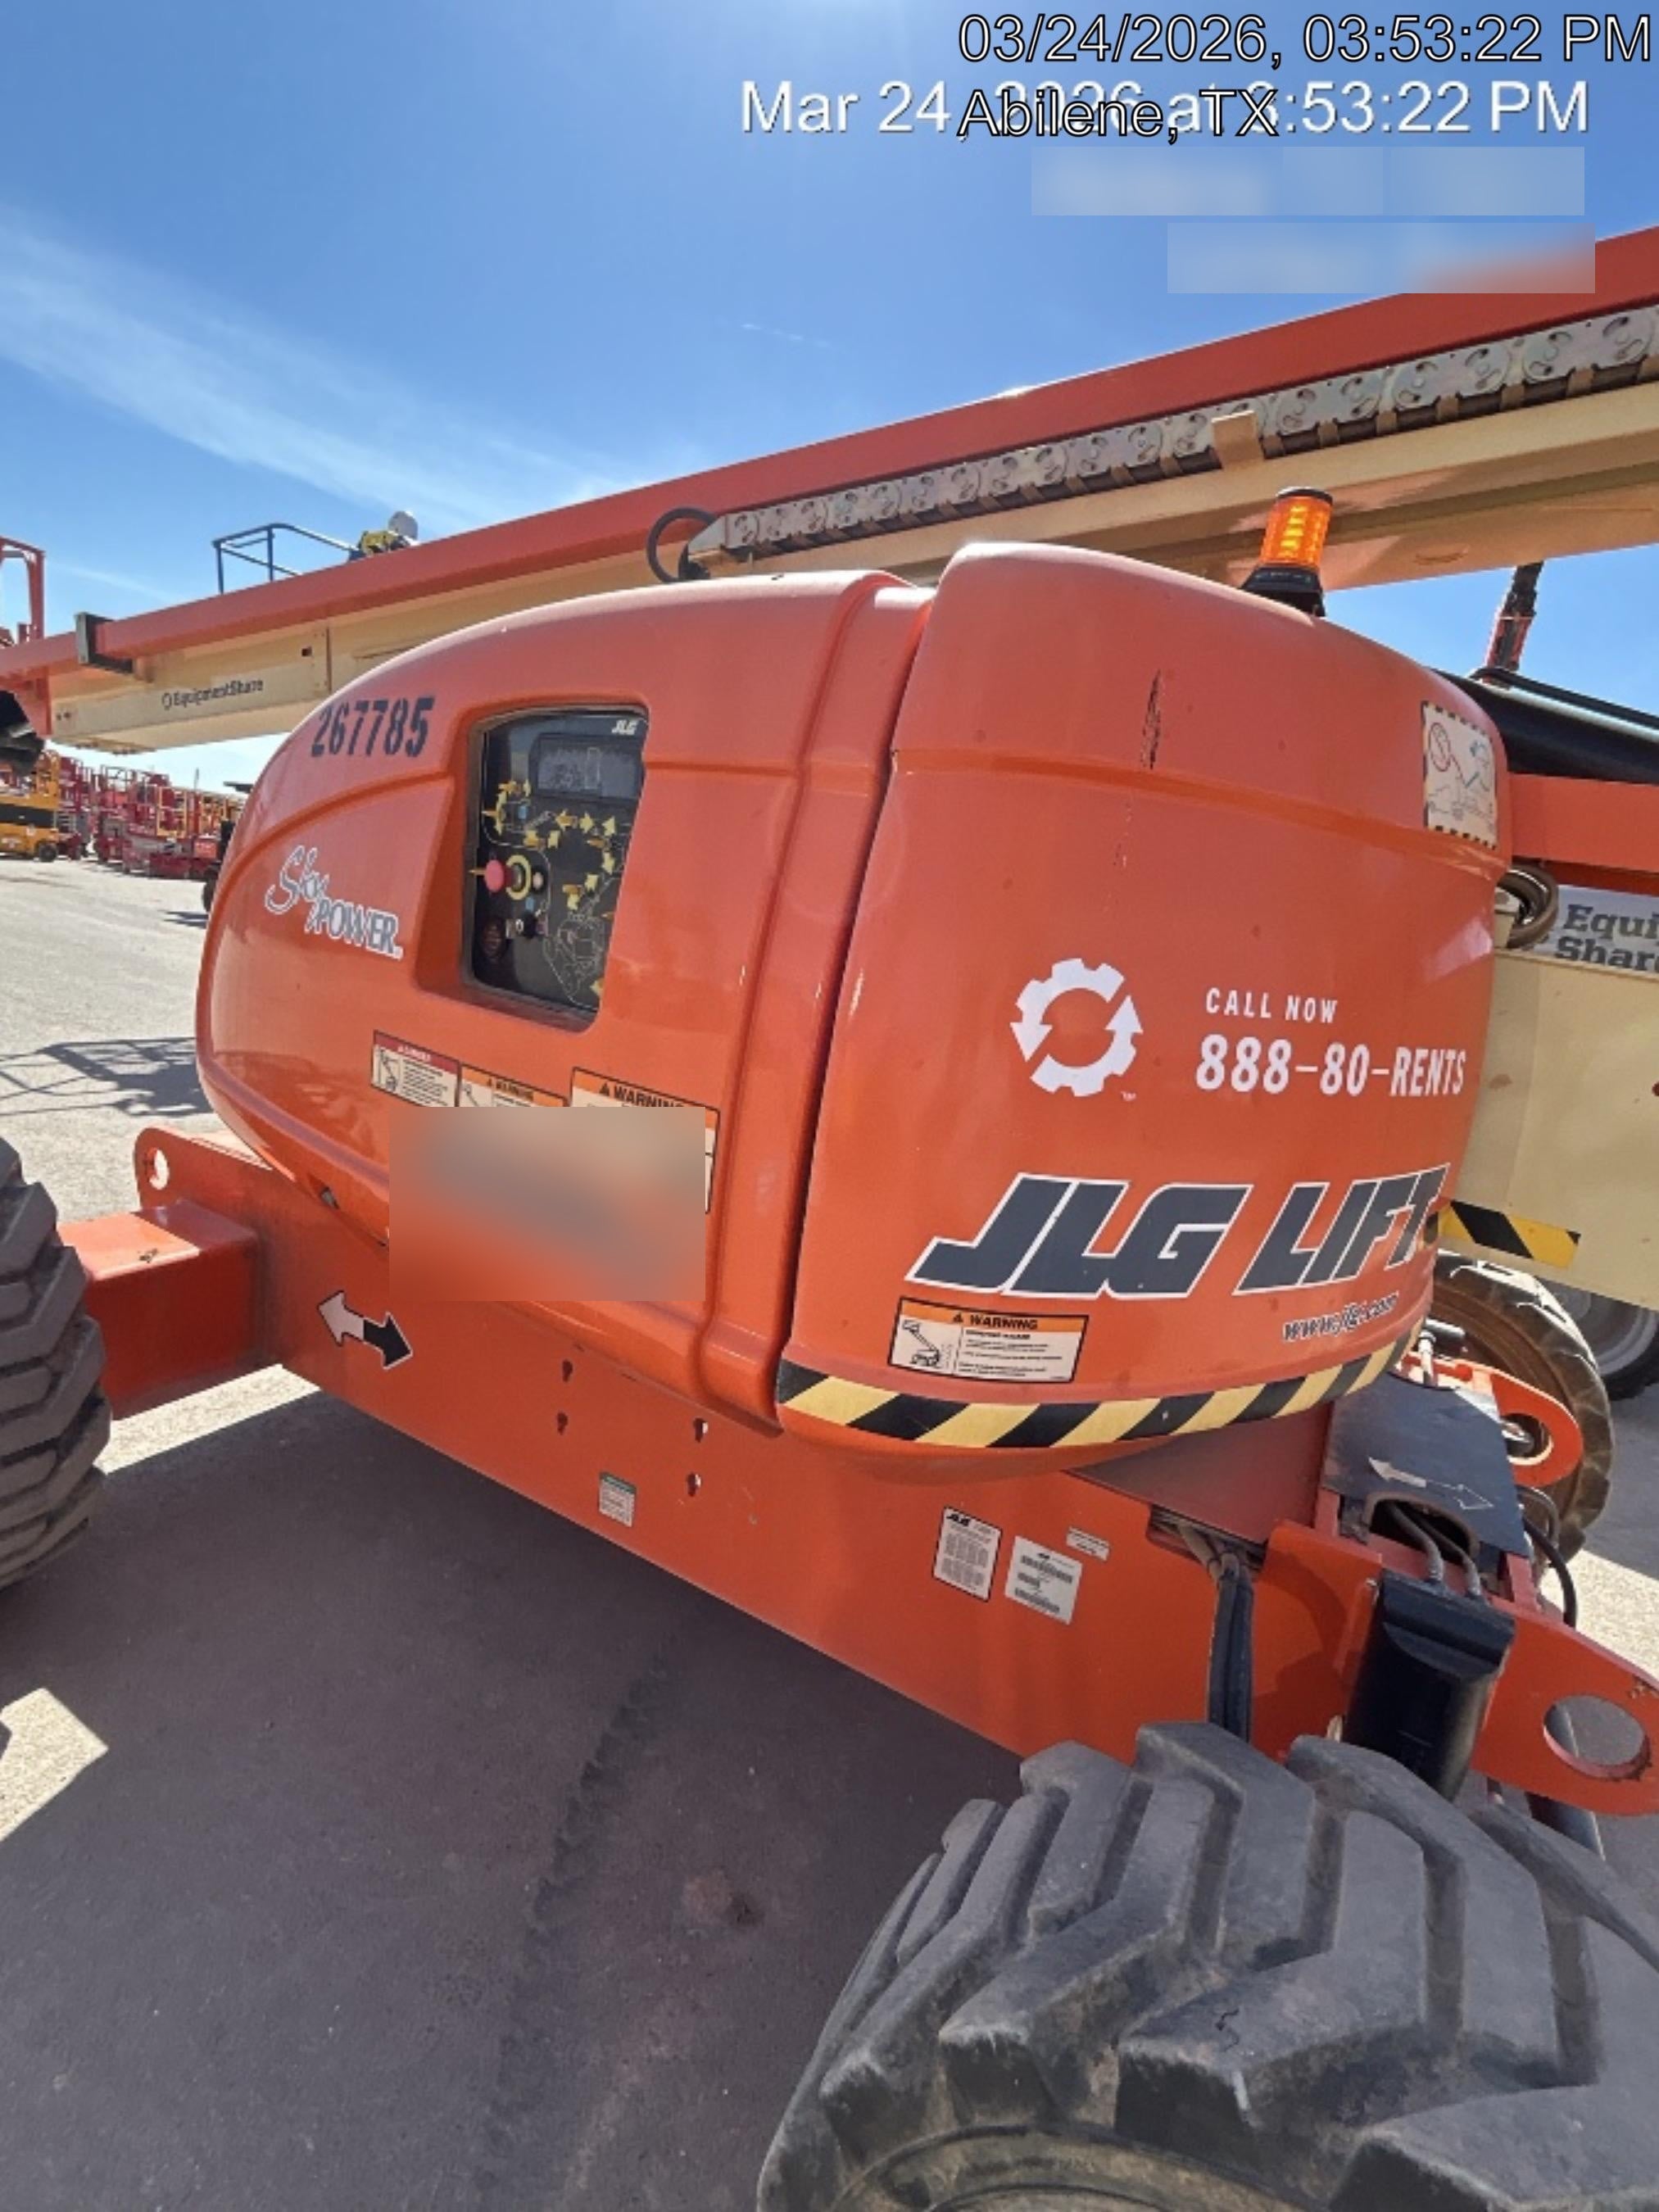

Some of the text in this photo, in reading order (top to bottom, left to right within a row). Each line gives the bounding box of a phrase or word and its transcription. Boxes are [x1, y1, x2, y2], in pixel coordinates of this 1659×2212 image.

[310, 697, 436, 757] 267785
[315, 897, 399, 958] POWER
[1562, 904, 1659, 941] Equi
[1205, 986, 1339, 1023] CALL NOW
[1195, 1033, 1466, 1097] 888-80-RENTS
[904, 1162, 1451, 1299] JLG LIFT
[969, 1313, 1039, 1331] WARNING
